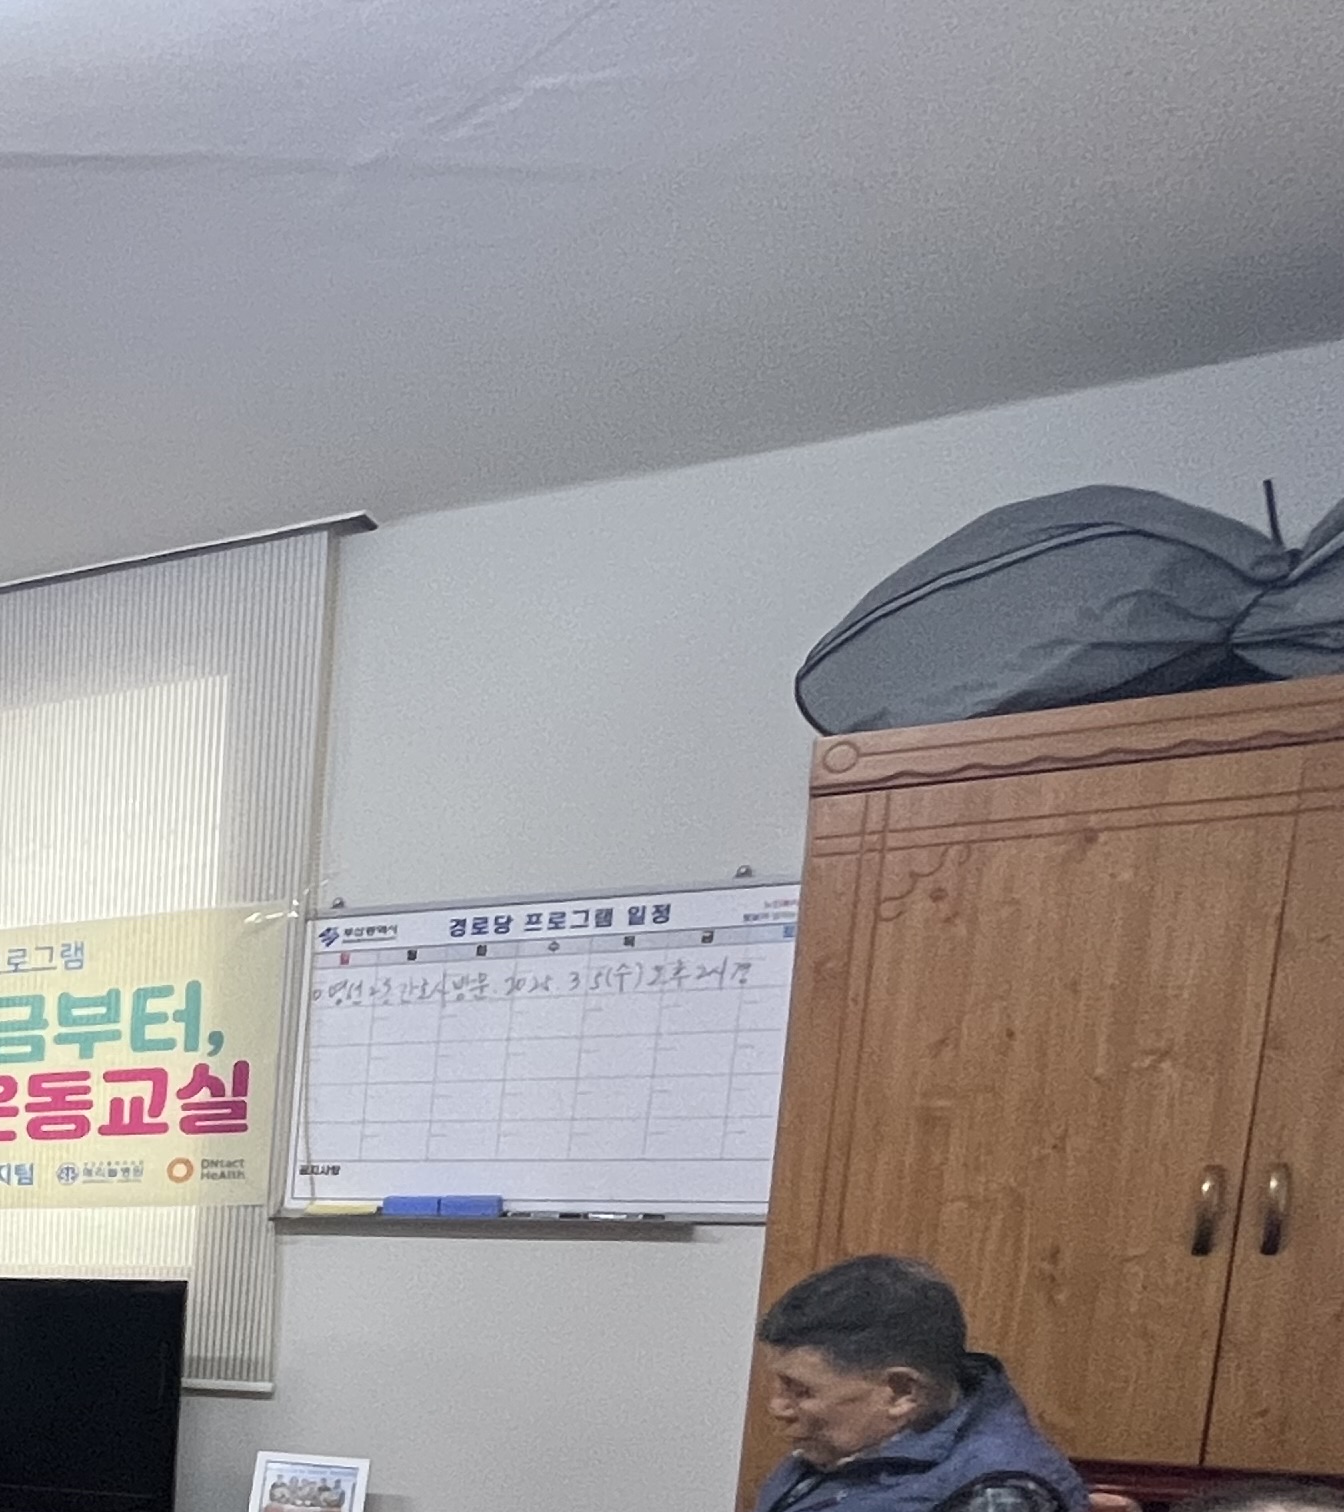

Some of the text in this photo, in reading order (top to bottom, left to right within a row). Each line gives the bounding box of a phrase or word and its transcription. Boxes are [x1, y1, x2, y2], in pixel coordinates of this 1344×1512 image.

[450, 903, 672, 938] 경로당 프로그램 일정
